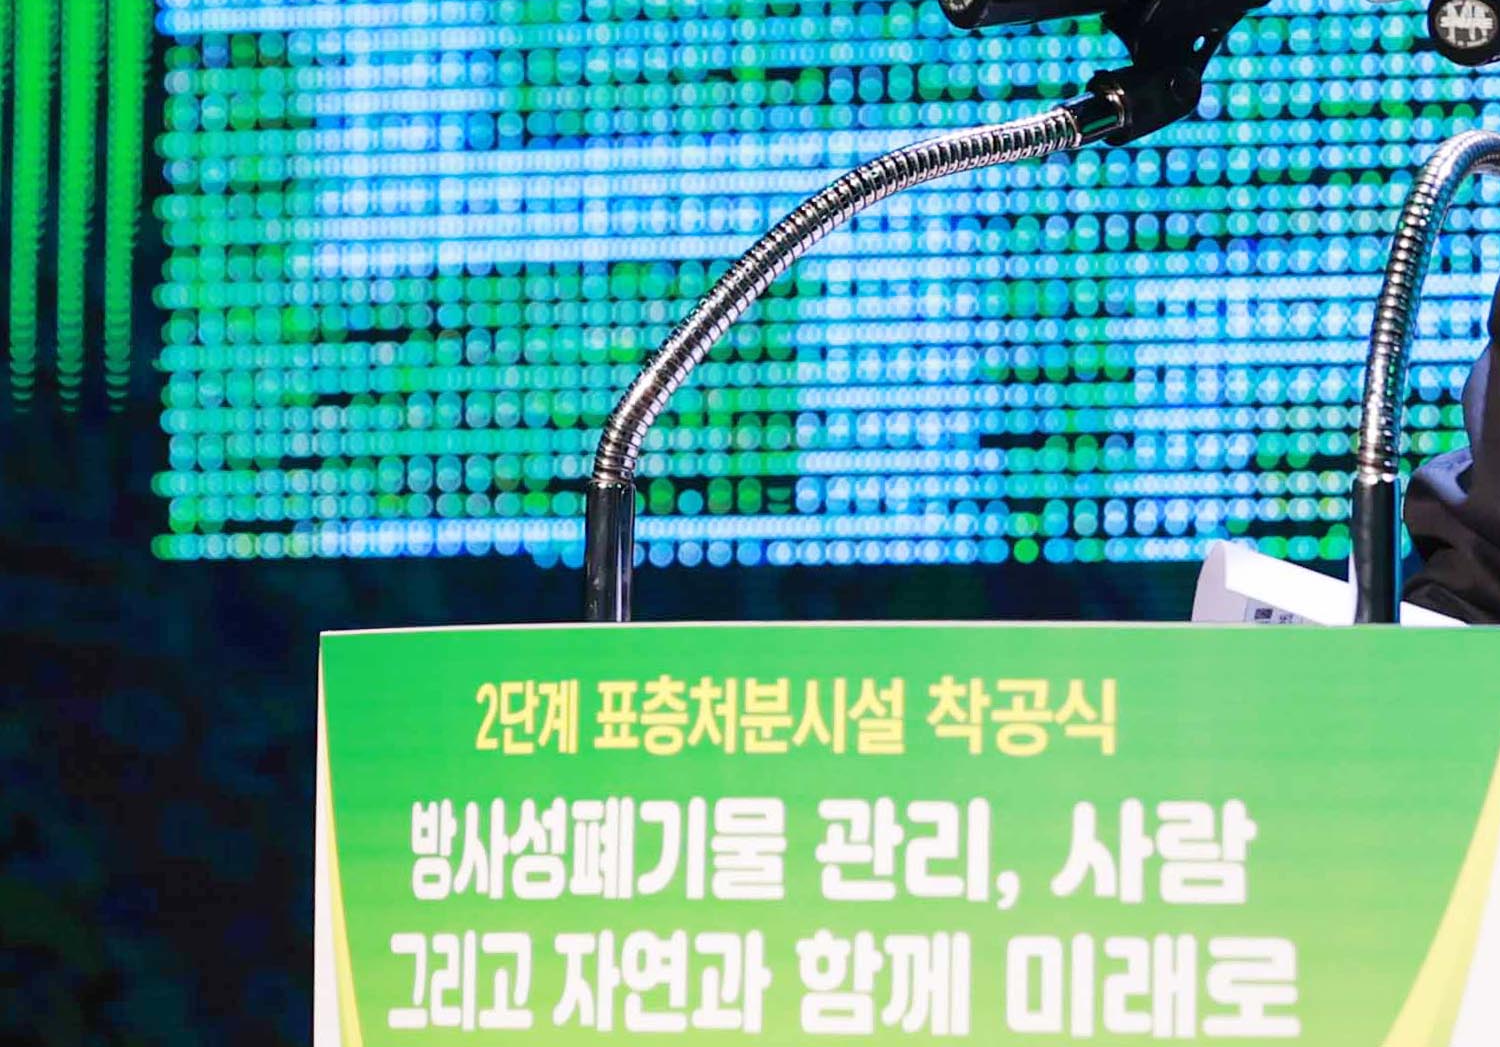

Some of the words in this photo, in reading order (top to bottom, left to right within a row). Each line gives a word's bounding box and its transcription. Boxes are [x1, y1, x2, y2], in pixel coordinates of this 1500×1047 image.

[475, 678, 579, 754] 2단계
[593, 674, 906, 755] 표층처분시설
[926, 674, 1117, 757] 착공식
[411, 796, 787, 901] 방사성폐기물
[815, 796, 1020, 909] 관리,
[1050, 798, 1257, 904] 사람
[387, 929, 533, 1032] 그리고
[552, 928, 773, 1034] 자연과
[796, 928, 971, 1036] 함께
[1005, 931, 1302, 1038] 미래로
